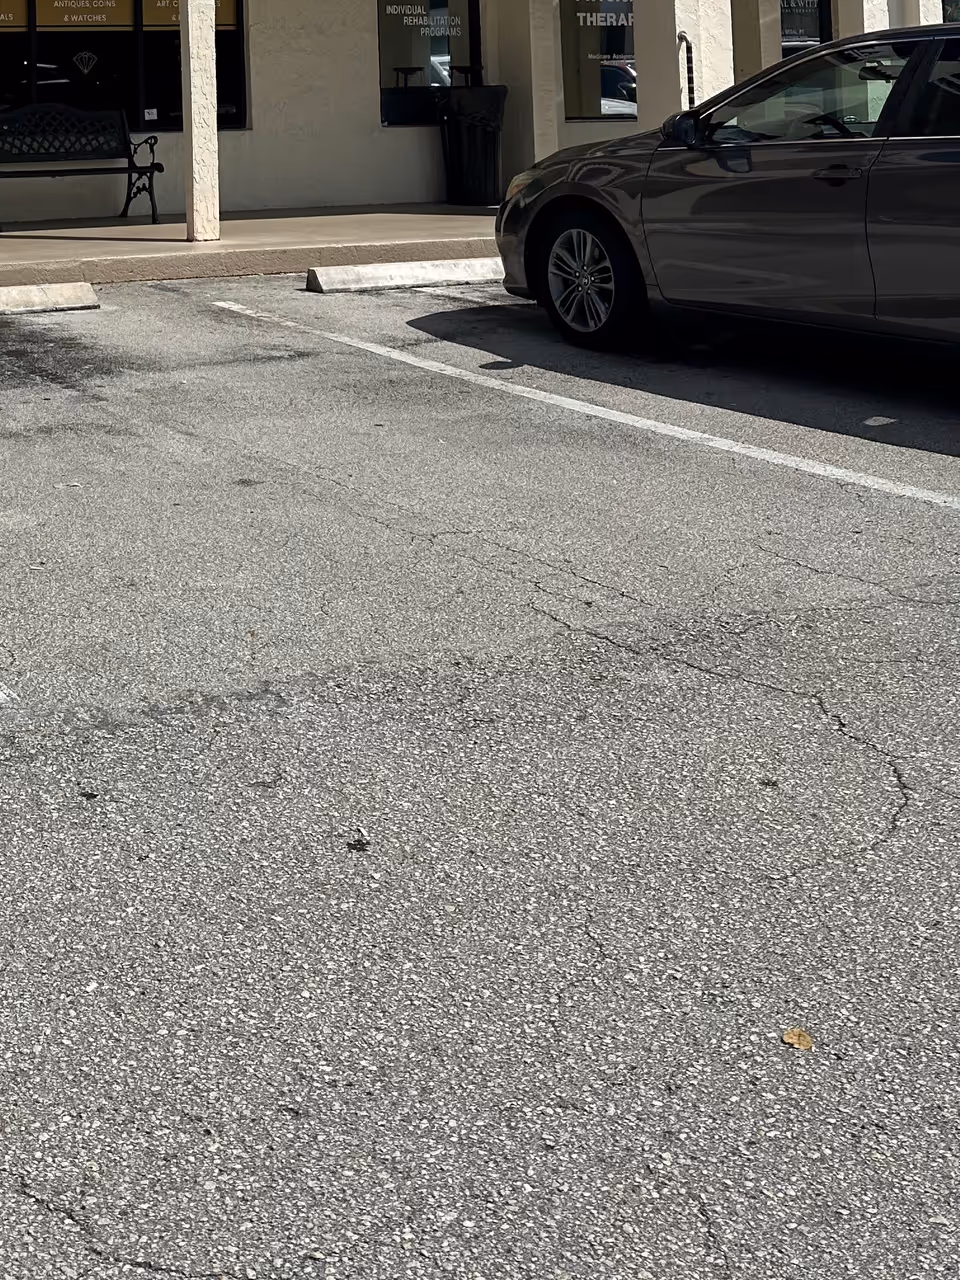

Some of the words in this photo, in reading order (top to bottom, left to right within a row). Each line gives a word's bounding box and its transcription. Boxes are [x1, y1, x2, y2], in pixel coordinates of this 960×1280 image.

[790, 0, 797, 7] &
[386, 5, 427, 14] INDIVIDUAL
[63, 14, 69, 22] &
[70, 14, 107, 22] WATCHES
[403, 16, 461, 26] REHABILITATION
[420, 27, 462, 37] PROGRAMS
